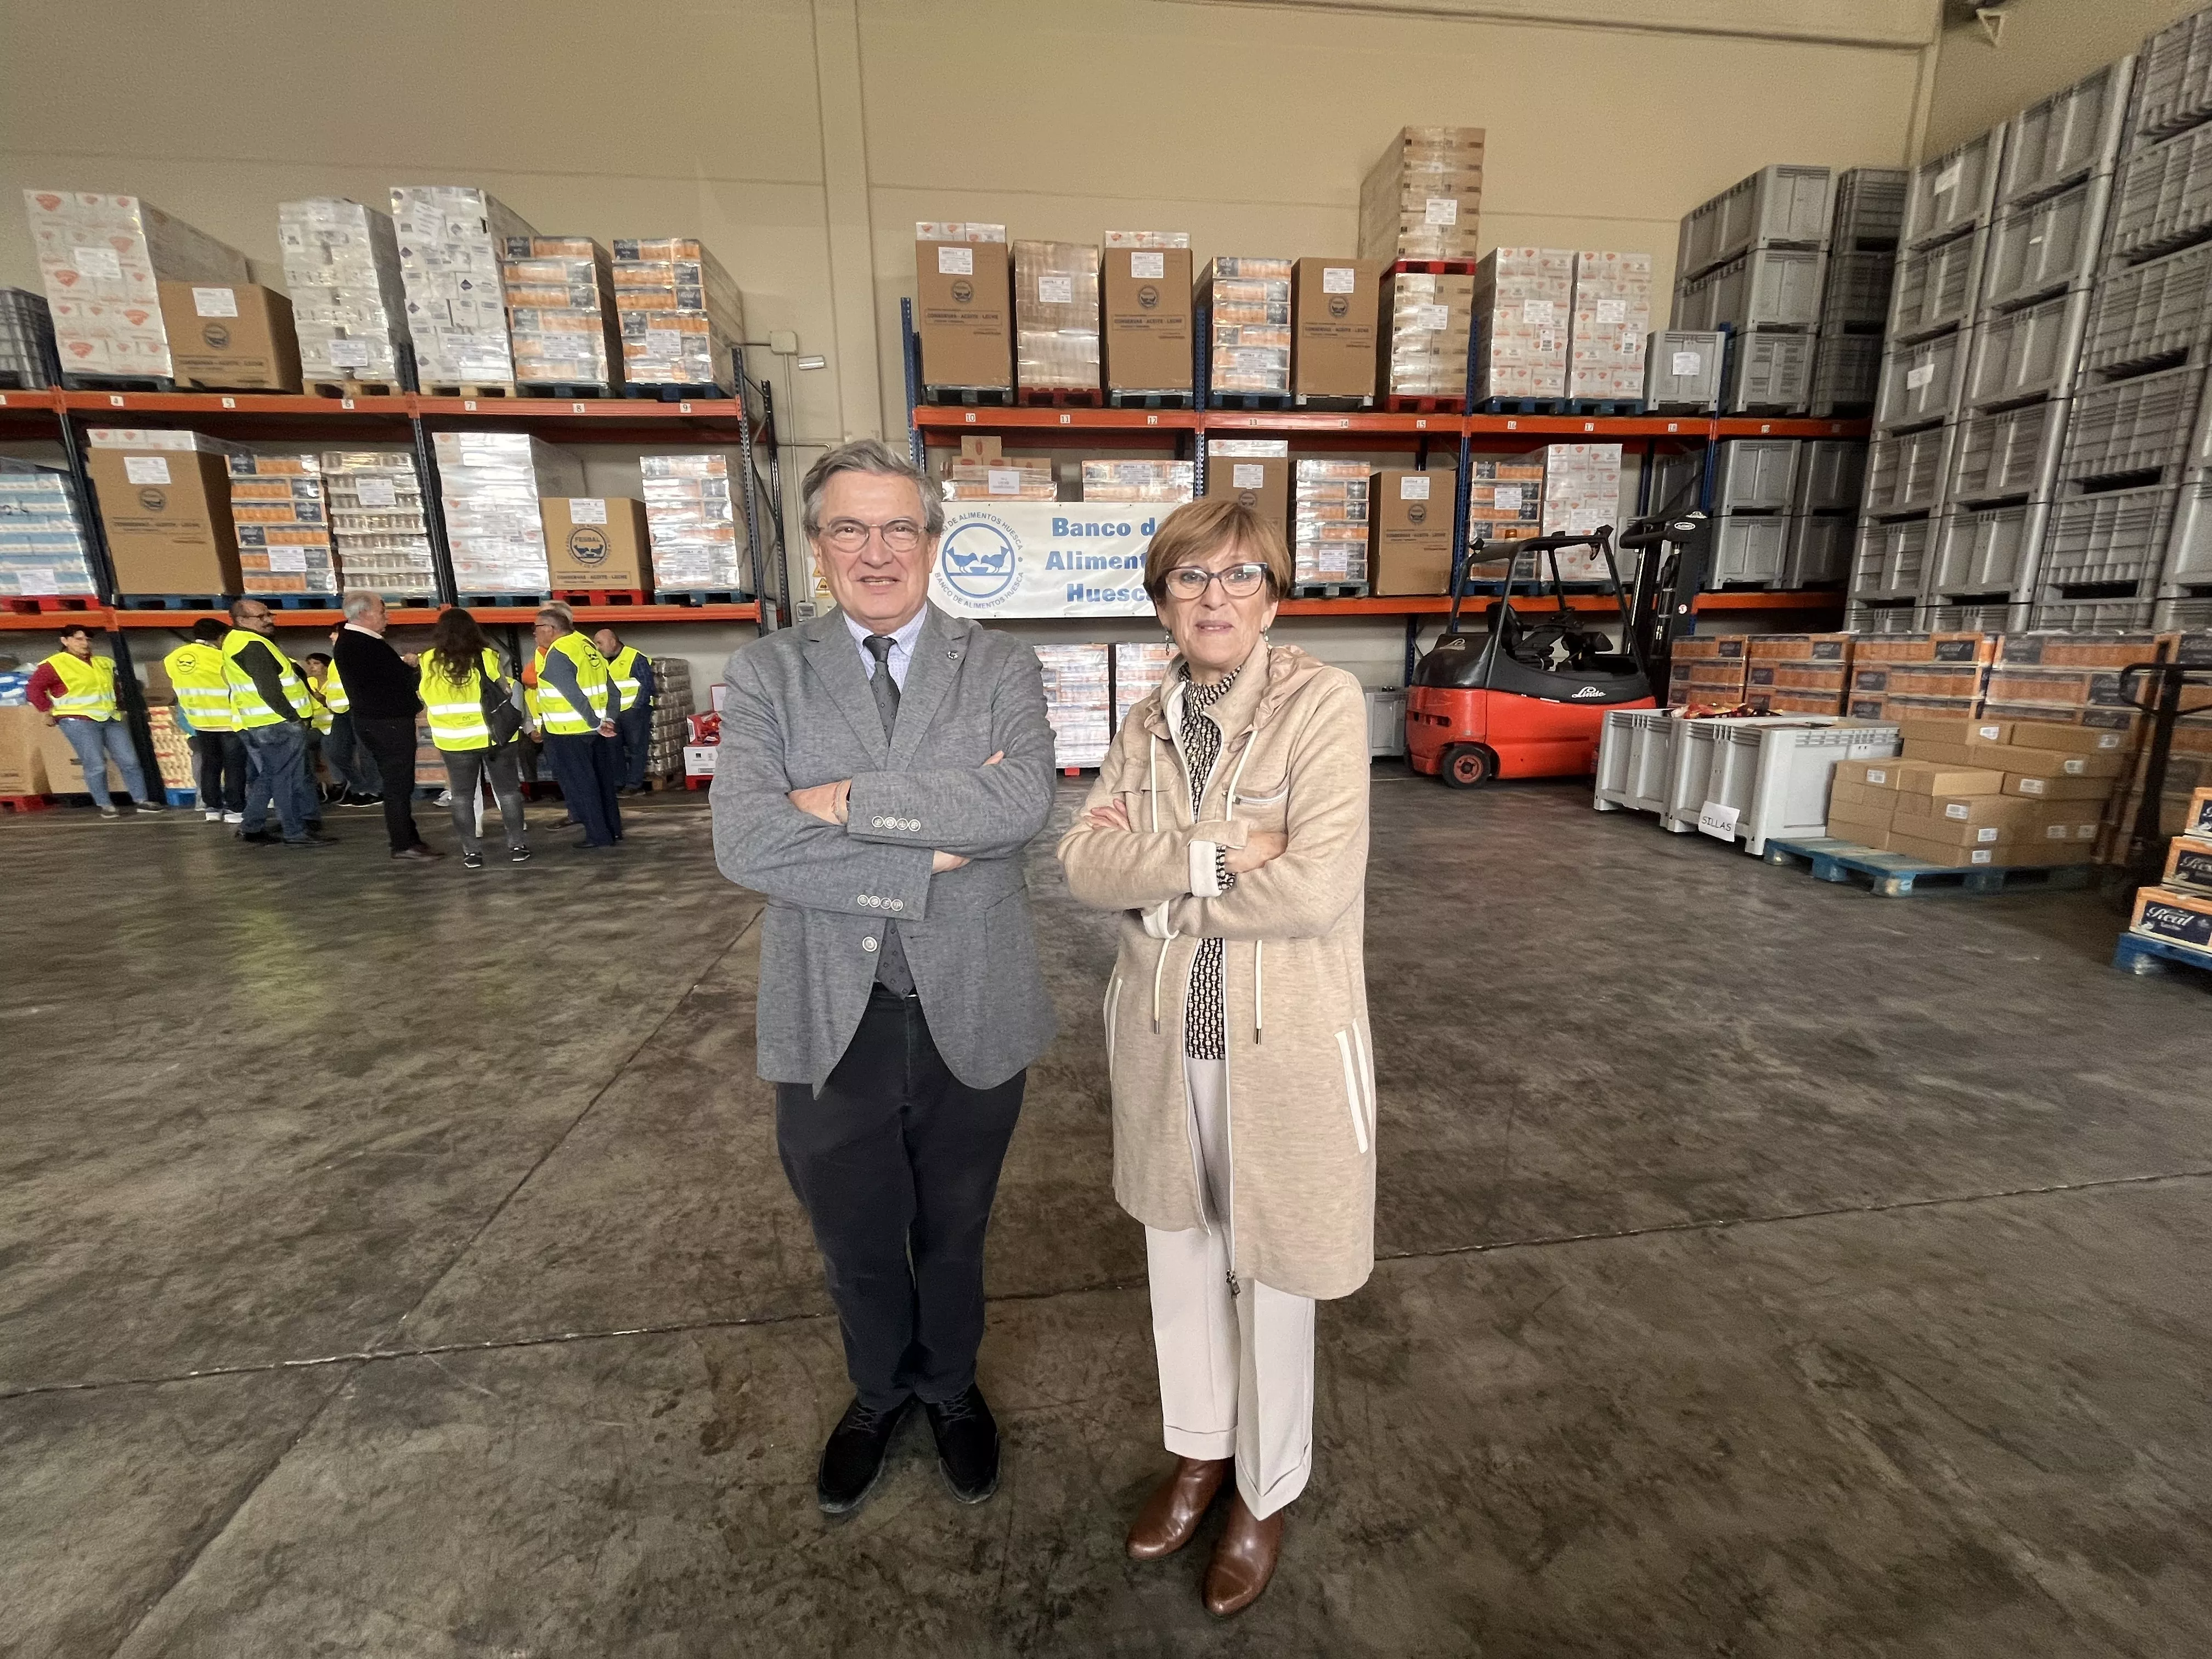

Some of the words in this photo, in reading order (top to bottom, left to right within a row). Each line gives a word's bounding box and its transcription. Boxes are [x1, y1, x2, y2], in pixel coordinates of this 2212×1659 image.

[345, 398, 351, 408] 6
[949, 517, 958, 527] DE
[959, 511, 1002, 524] ALIMENTOS
[1002, 522, 1023, 550] HUESCA
[1052, 517, 1131, 537] Banco
[1141, 517, 1158, 537] d
[1045, 551, 1147, 570] Aliment
[934, 572, 953, 597] BANCO
[952, 594, 962, 605] DE
[964, 596, 1005, 609] ALIMENTOS
[1006, 572, 1024, 599] HUESCA
[1571, 686, 1606, 698] Linde
[1701, 816, 1732, 832] SILLAS
[2146, 907, 2195, 926] Real
